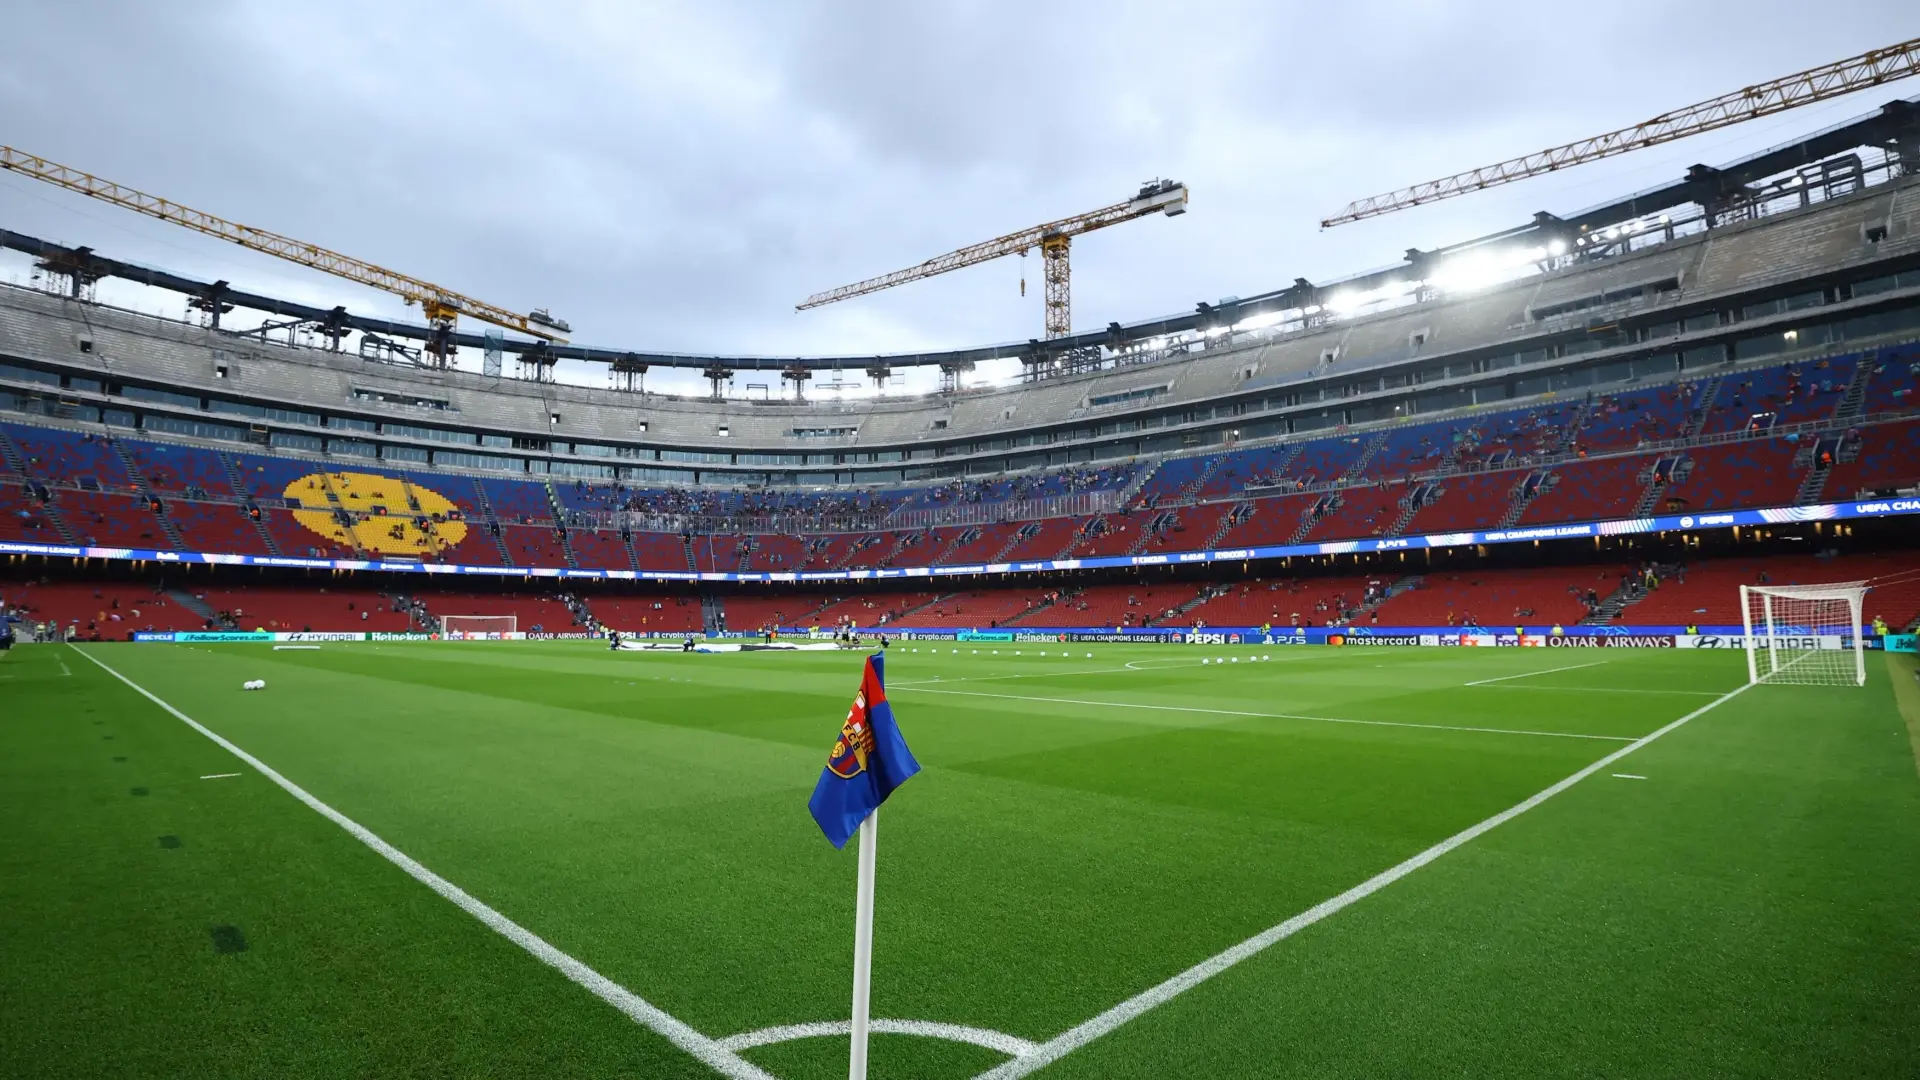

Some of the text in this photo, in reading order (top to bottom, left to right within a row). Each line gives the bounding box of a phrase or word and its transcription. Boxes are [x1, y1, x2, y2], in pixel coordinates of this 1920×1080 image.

[1856, 503, 1891, 513] UEFA
[1699, 515, 1734, 525] PEPSI
[1485, 525, 1591, 541] UEFA CHAMPIONS LEAGUE
[308, 633, 356, 641] HYUNDAI
[371, 632, 428, 641] Heineken
[528, 632, 588, 640] QATAR AIRWAYS
[605, 631, 636, 640] PPSI
[777, 632, 810, 640] mastercard
[918, 633, 955, 641] crypto.com
[1015, 632, 1058, 643] Heineken
[1097, 634, 1132, 643] CHAMPIONS
[1133, 634, 1156, 642] LEAGUE
[1186, 635, 1226, 645] PEPSI
[1277, 636, 1306, 645] PS5
[1346, 635, 1417, 646] mastercard
[1439, 635, 1480, 646] FedEx
[1496, 635, 1539, 647] FedEx
[1549, 635, 1670, 648] QATAR AIRWAYS
[1730, 637, 1822, 649] HUNDAI
[842, 723, 861, 751] FCB
